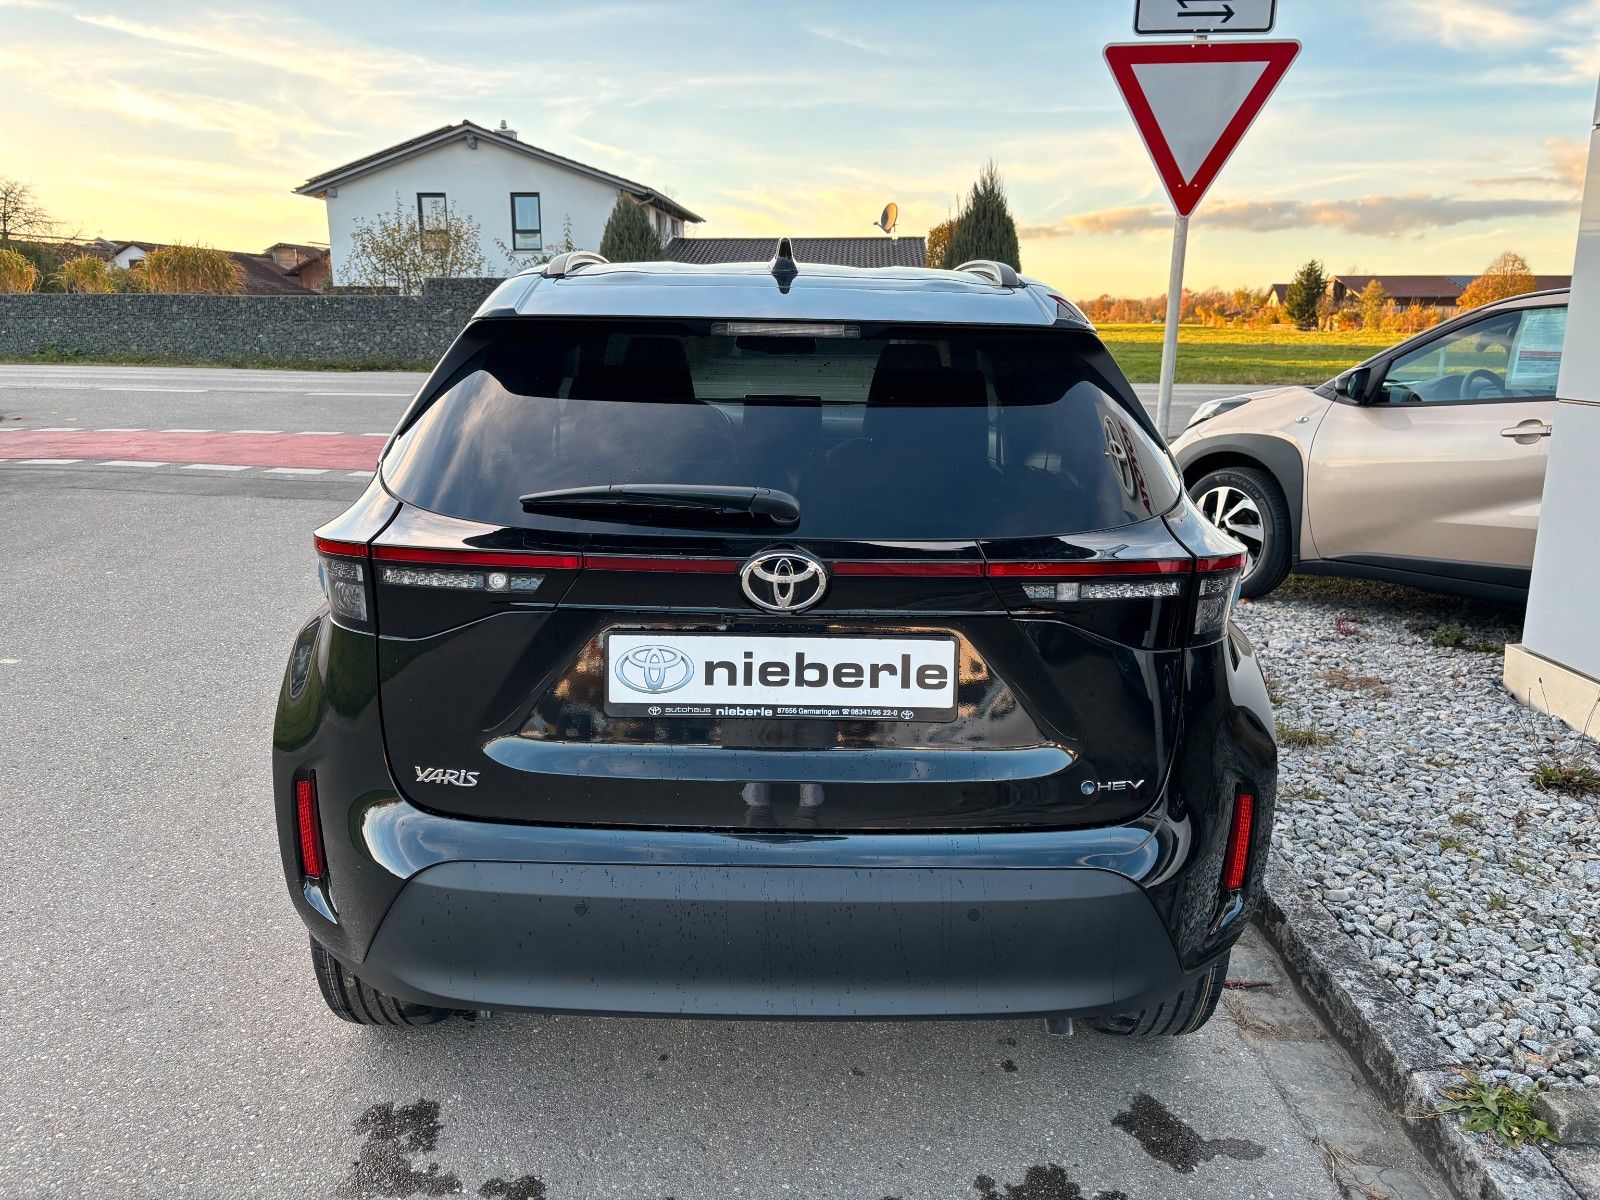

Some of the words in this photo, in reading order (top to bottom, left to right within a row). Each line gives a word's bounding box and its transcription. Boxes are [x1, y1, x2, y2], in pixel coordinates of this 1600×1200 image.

[704, 651, 948, 690] nieberle
[715, 706, 773, 716] nieberle
[798, 707, 840, 716] Germaringen
[414, 765, 481, 787] YARIS
[1096, 779, 1145, 791] HEV
